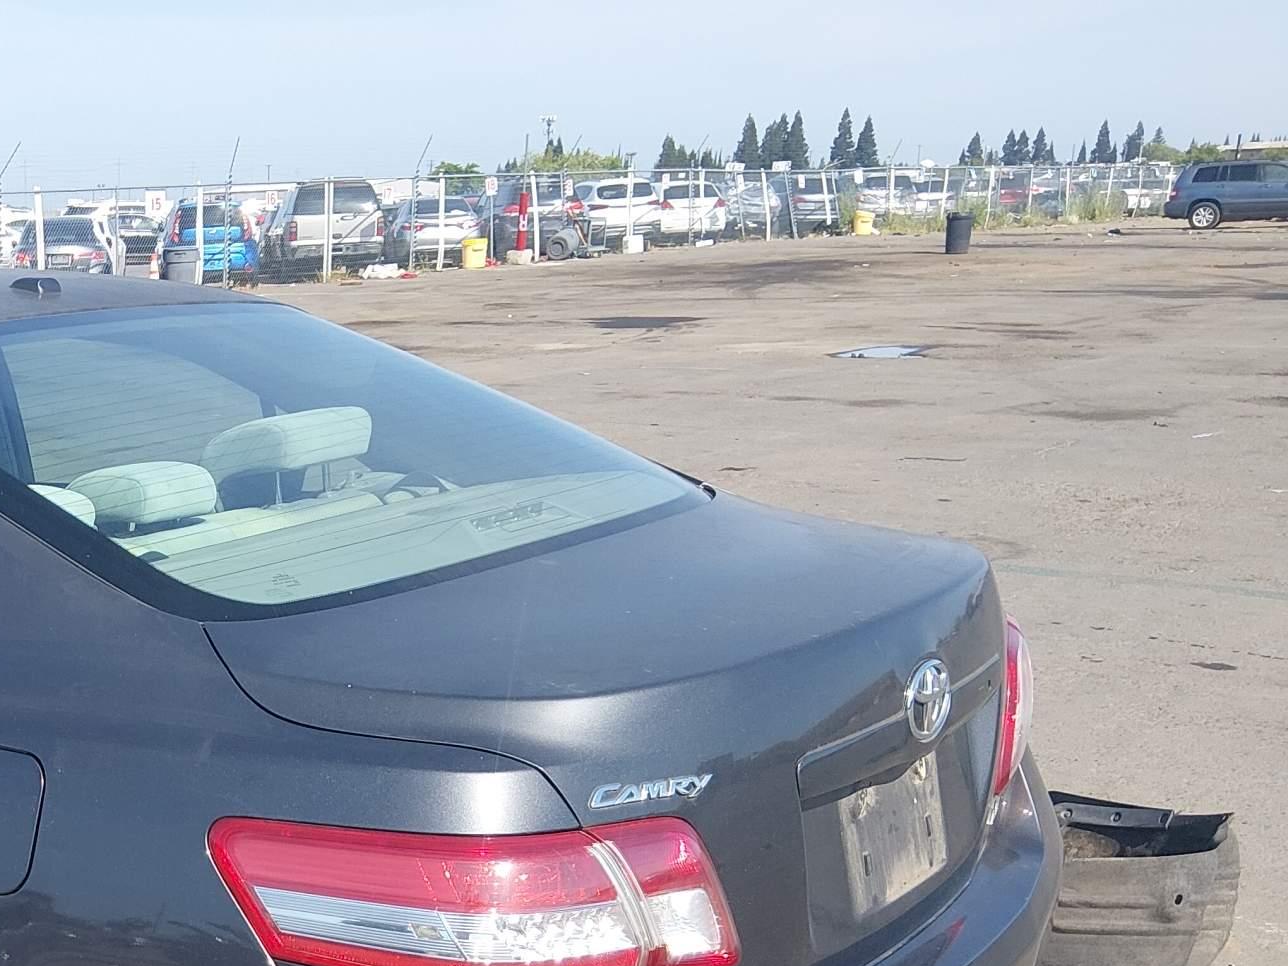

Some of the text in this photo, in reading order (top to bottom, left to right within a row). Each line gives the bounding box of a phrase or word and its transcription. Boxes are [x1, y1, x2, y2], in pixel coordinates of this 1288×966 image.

[152, 197, 161, 210] 15
[267, 192, 276, 205] 16
[588, 774, 713, 809] CAMRY
